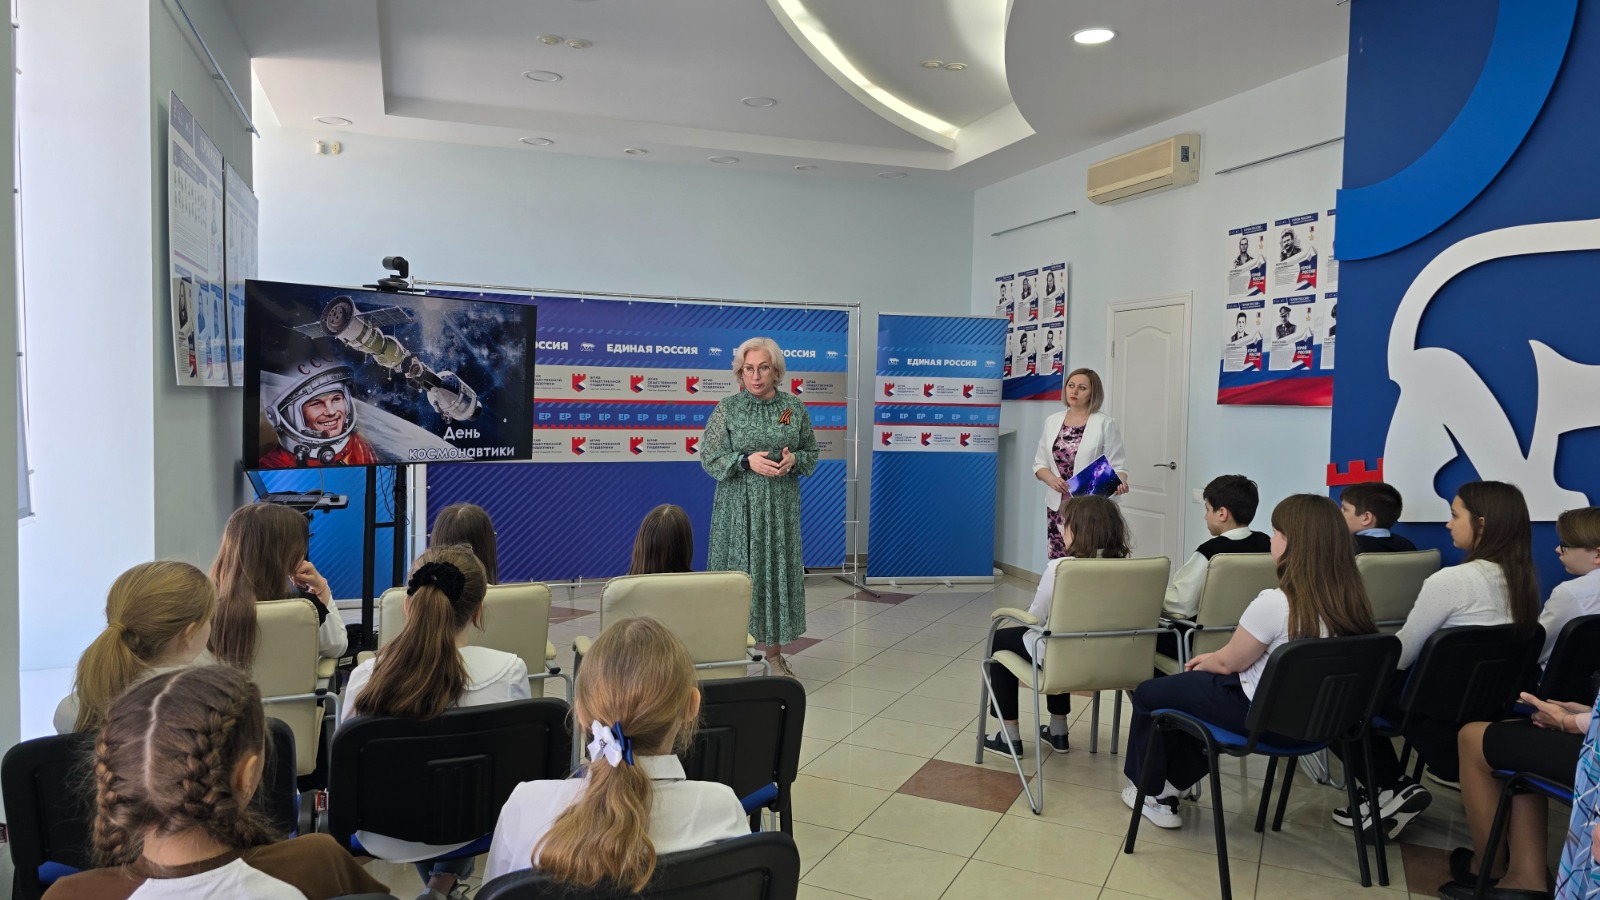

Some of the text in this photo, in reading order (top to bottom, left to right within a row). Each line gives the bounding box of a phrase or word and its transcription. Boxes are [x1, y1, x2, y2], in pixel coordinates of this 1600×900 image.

[606, 344, 698, 354] ЕДИНАЯ РОССИЯ
[782, 349, 816, 358] ОССИЯ
[443, 426, 480, 441] День
[408, 447, 514, 460] космонавтики
